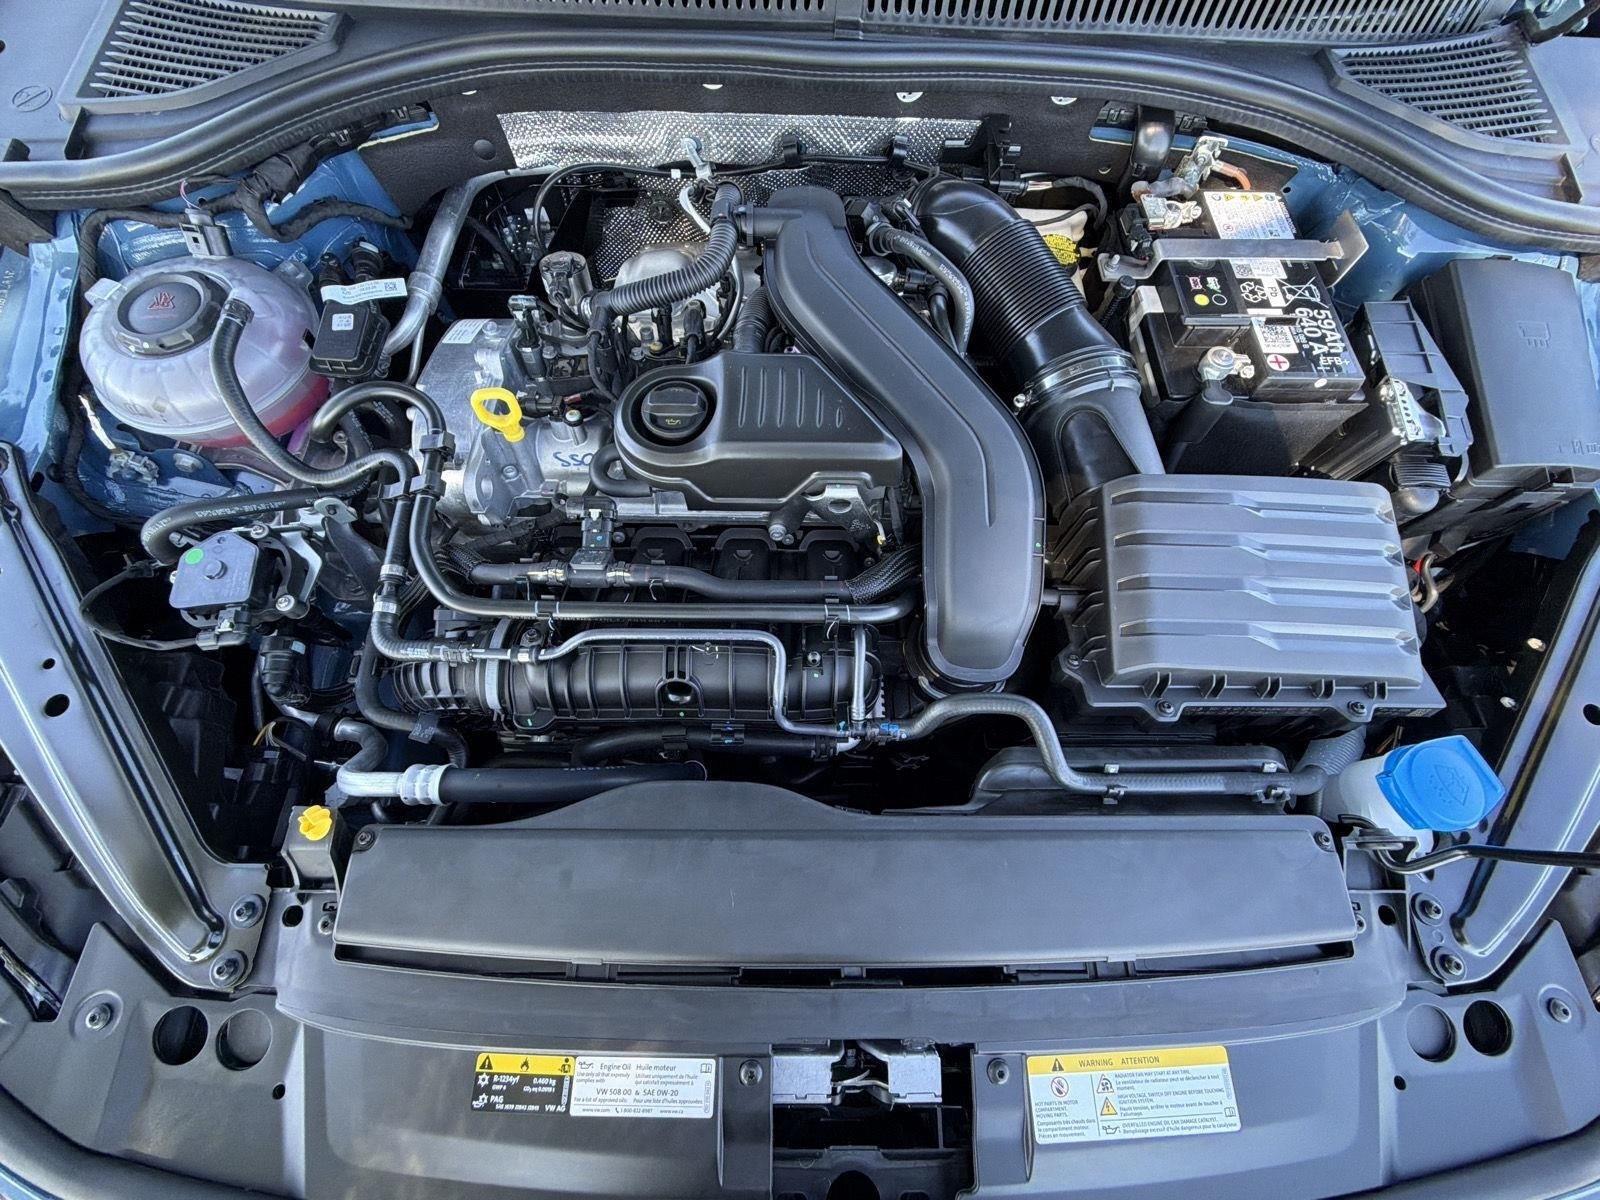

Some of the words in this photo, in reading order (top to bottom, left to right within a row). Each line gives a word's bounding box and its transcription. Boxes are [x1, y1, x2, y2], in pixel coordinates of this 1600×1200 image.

[1294, 307, 1322, 338] 640
[1309, 341, 1329, 355] A
[1314, 309, 1345, 353] 59Ah
[1320, 356, 1350, 366] EFB+
[600, 1062, 621, 1071] Engine
[1078, 1058, 1113, 1067] WARNING
[1121, 1056, 1160, 1065] ATTENTION
[493, 1074, 520, 1085] R-1234yf
